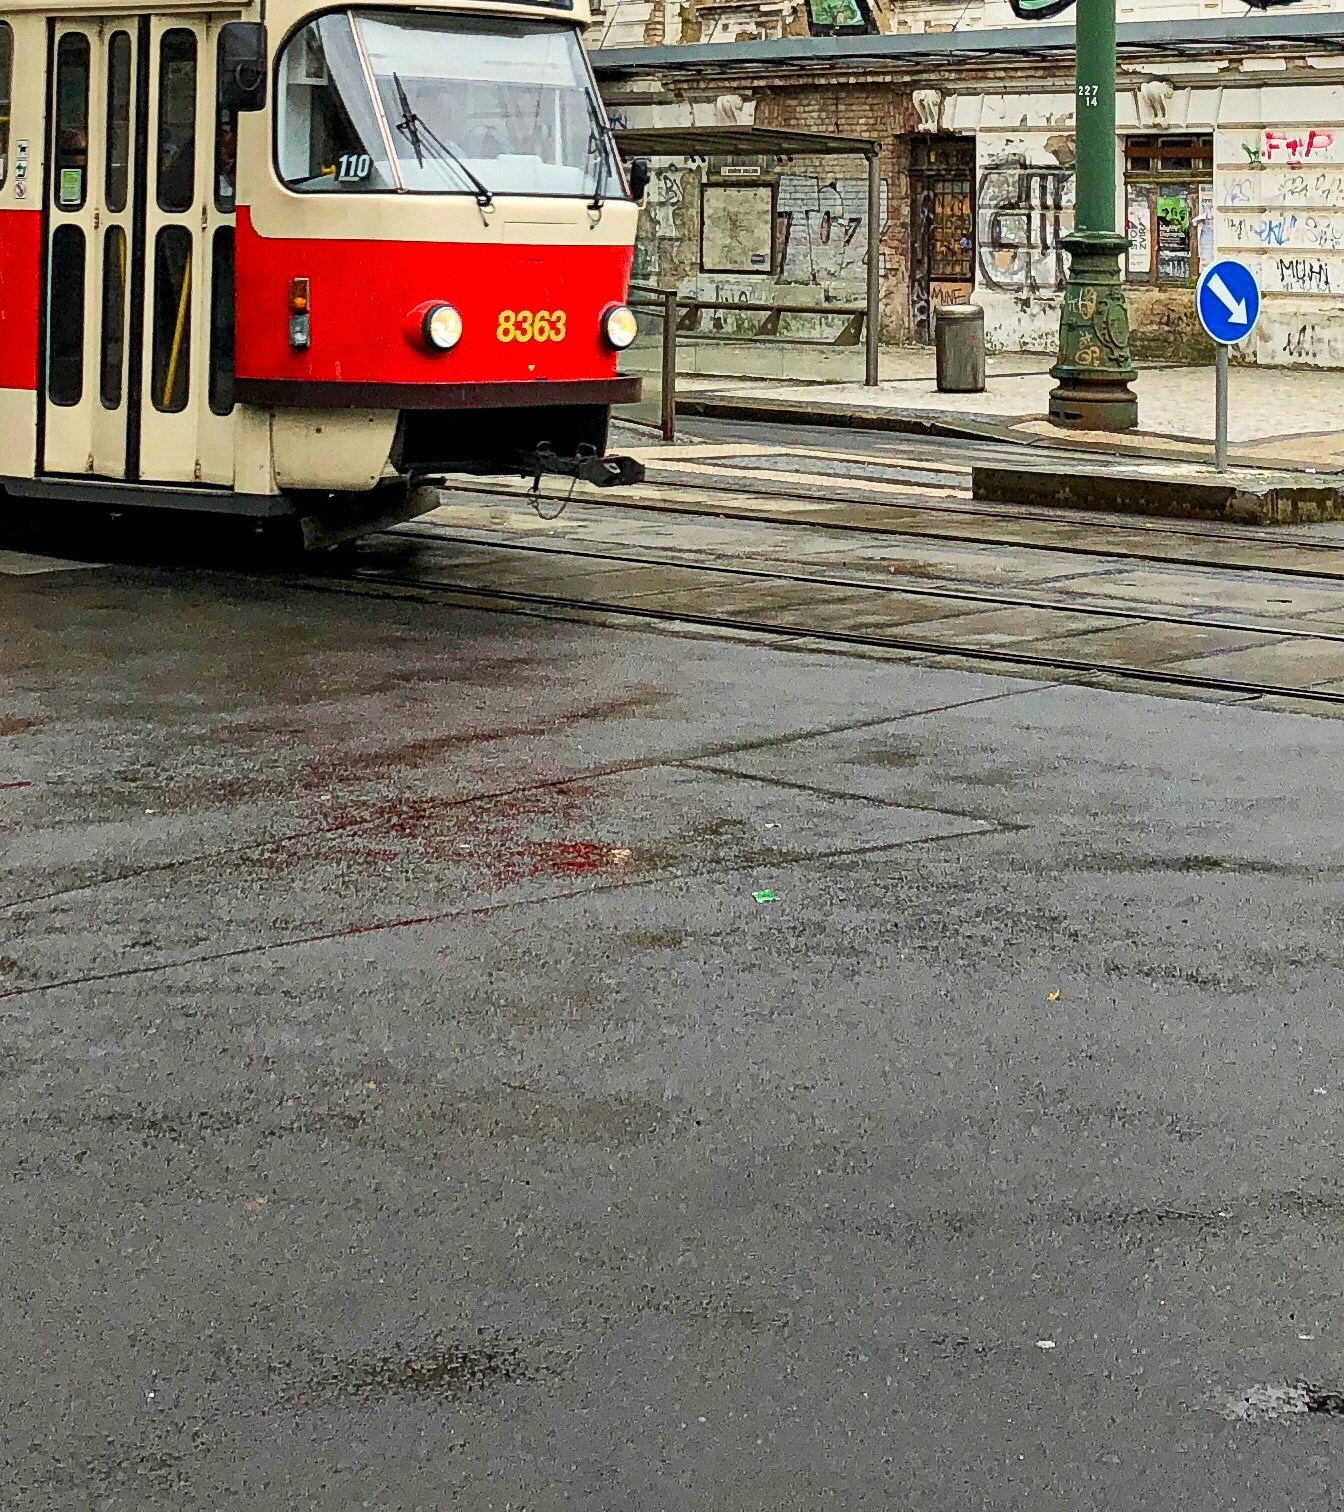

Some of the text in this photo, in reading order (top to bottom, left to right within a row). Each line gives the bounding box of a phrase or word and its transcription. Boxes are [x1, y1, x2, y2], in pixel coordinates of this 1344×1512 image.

[1078, 85, 1099, 96] 227
[1085, 96, 1098, 107] 14
[339, 154, 370, 179] 110
[496, 309, 567, 343] 8363
